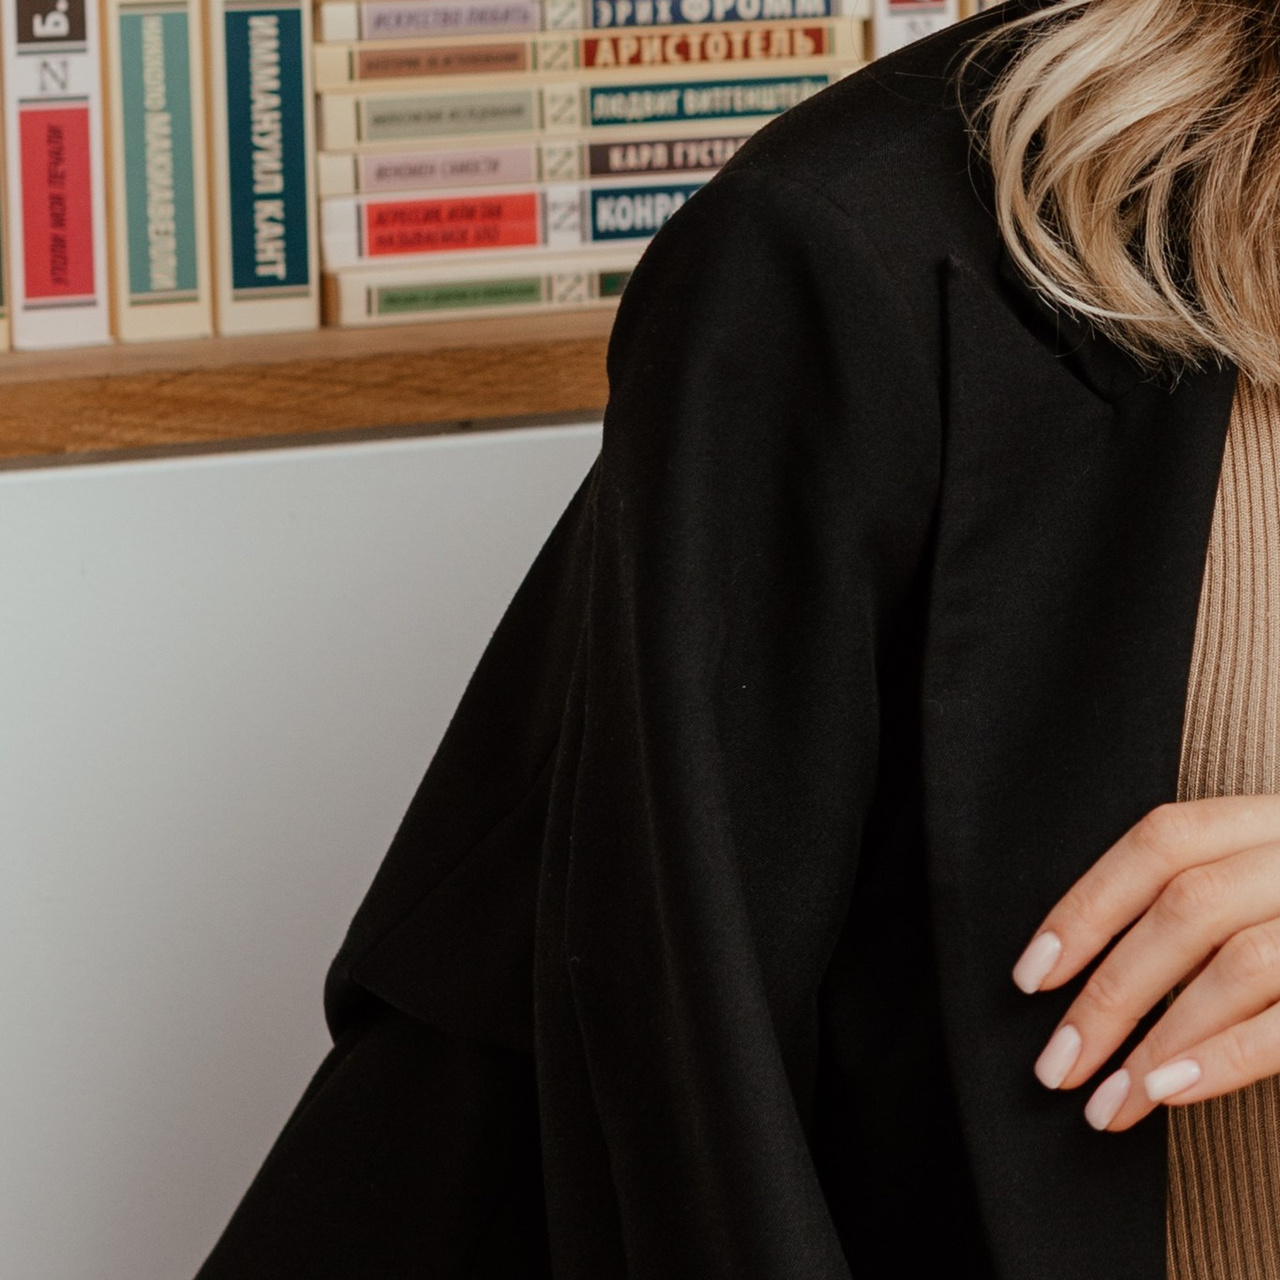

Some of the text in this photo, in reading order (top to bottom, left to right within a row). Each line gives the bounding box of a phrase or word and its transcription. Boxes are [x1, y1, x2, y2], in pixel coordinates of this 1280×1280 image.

[594, 28, 817, 67] АРИСТОТЕЛЬ
[593, 89, 681, 123] ЛЮДВИГ
[248, 15, 286, 279] ИММАНУИЛ КАНТ
[608, 142, 669, 171] КАРЛ
[596, 191, 699, 233] КОНРА
